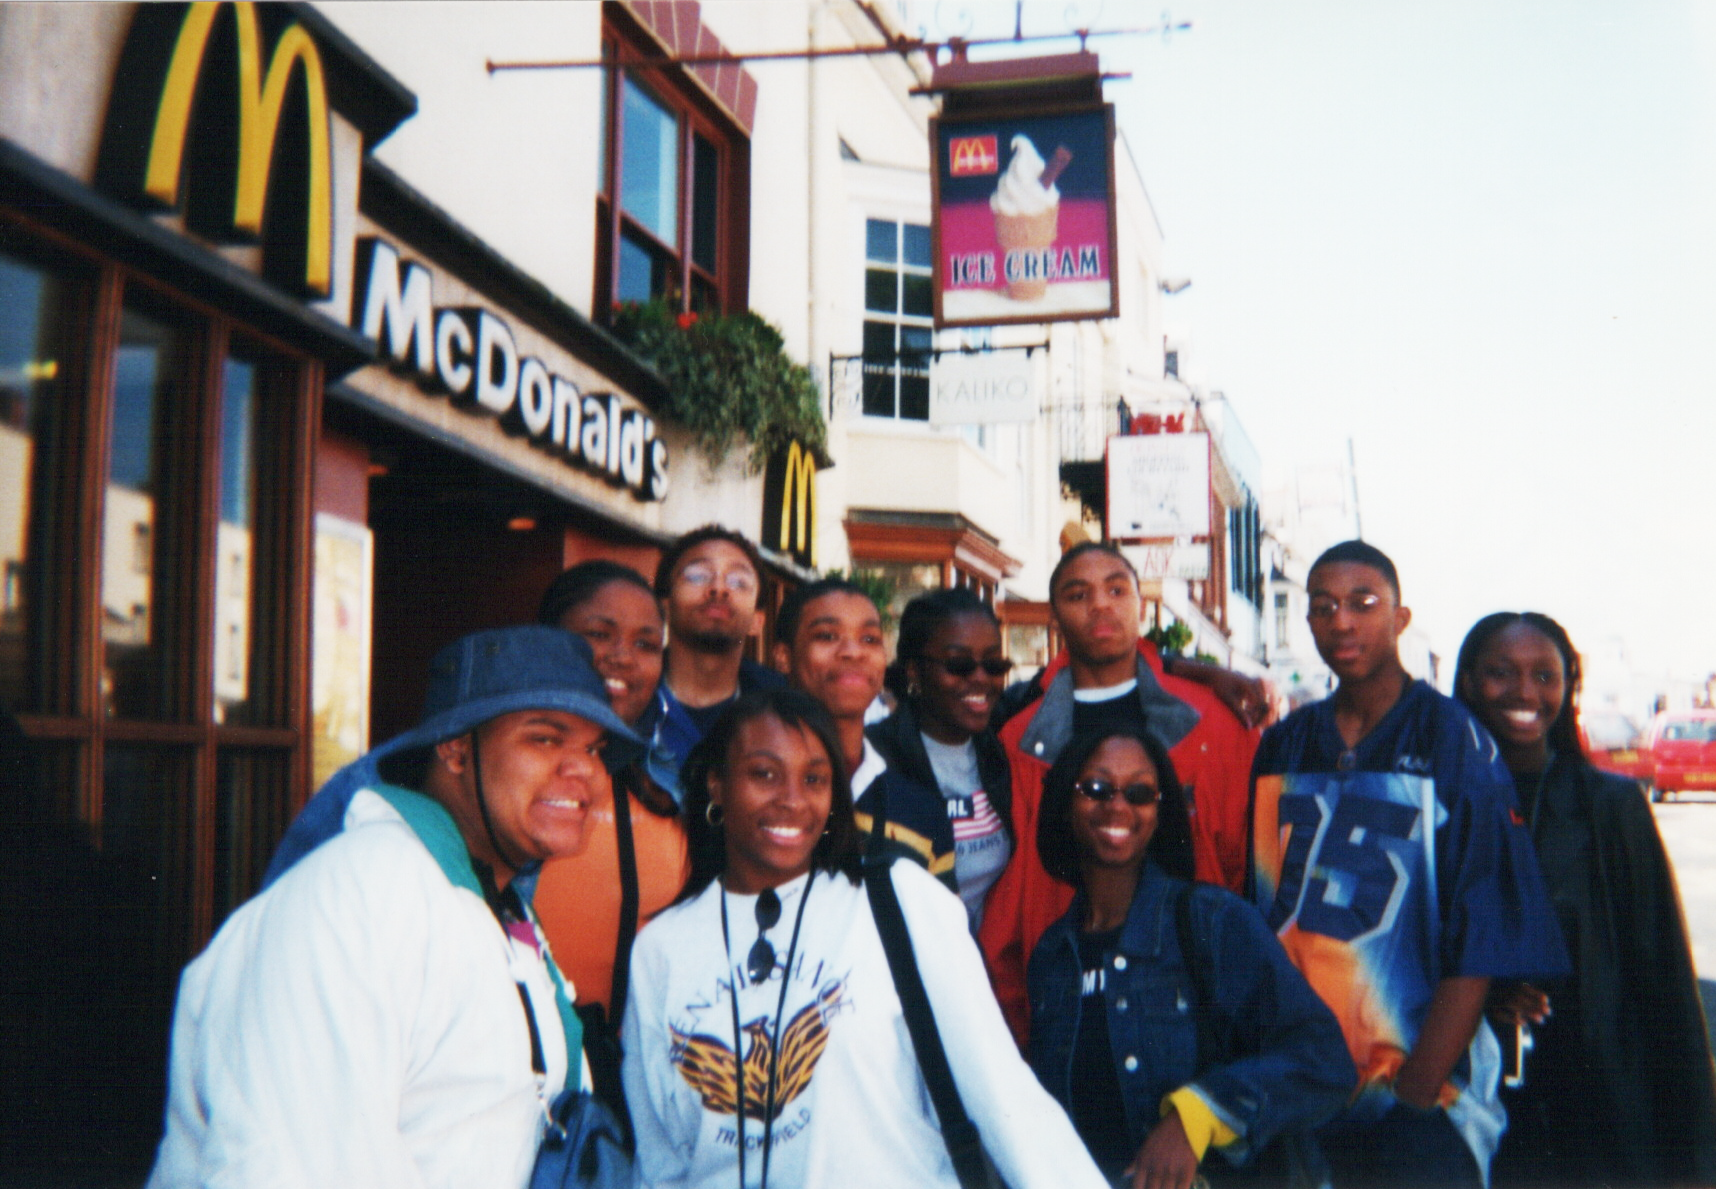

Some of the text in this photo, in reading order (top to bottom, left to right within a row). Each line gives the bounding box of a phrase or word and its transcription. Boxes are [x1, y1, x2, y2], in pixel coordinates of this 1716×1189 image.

[950, 245, 1101, 285] ICE CREAM
[364, 242, 668, 500] McDonald's
